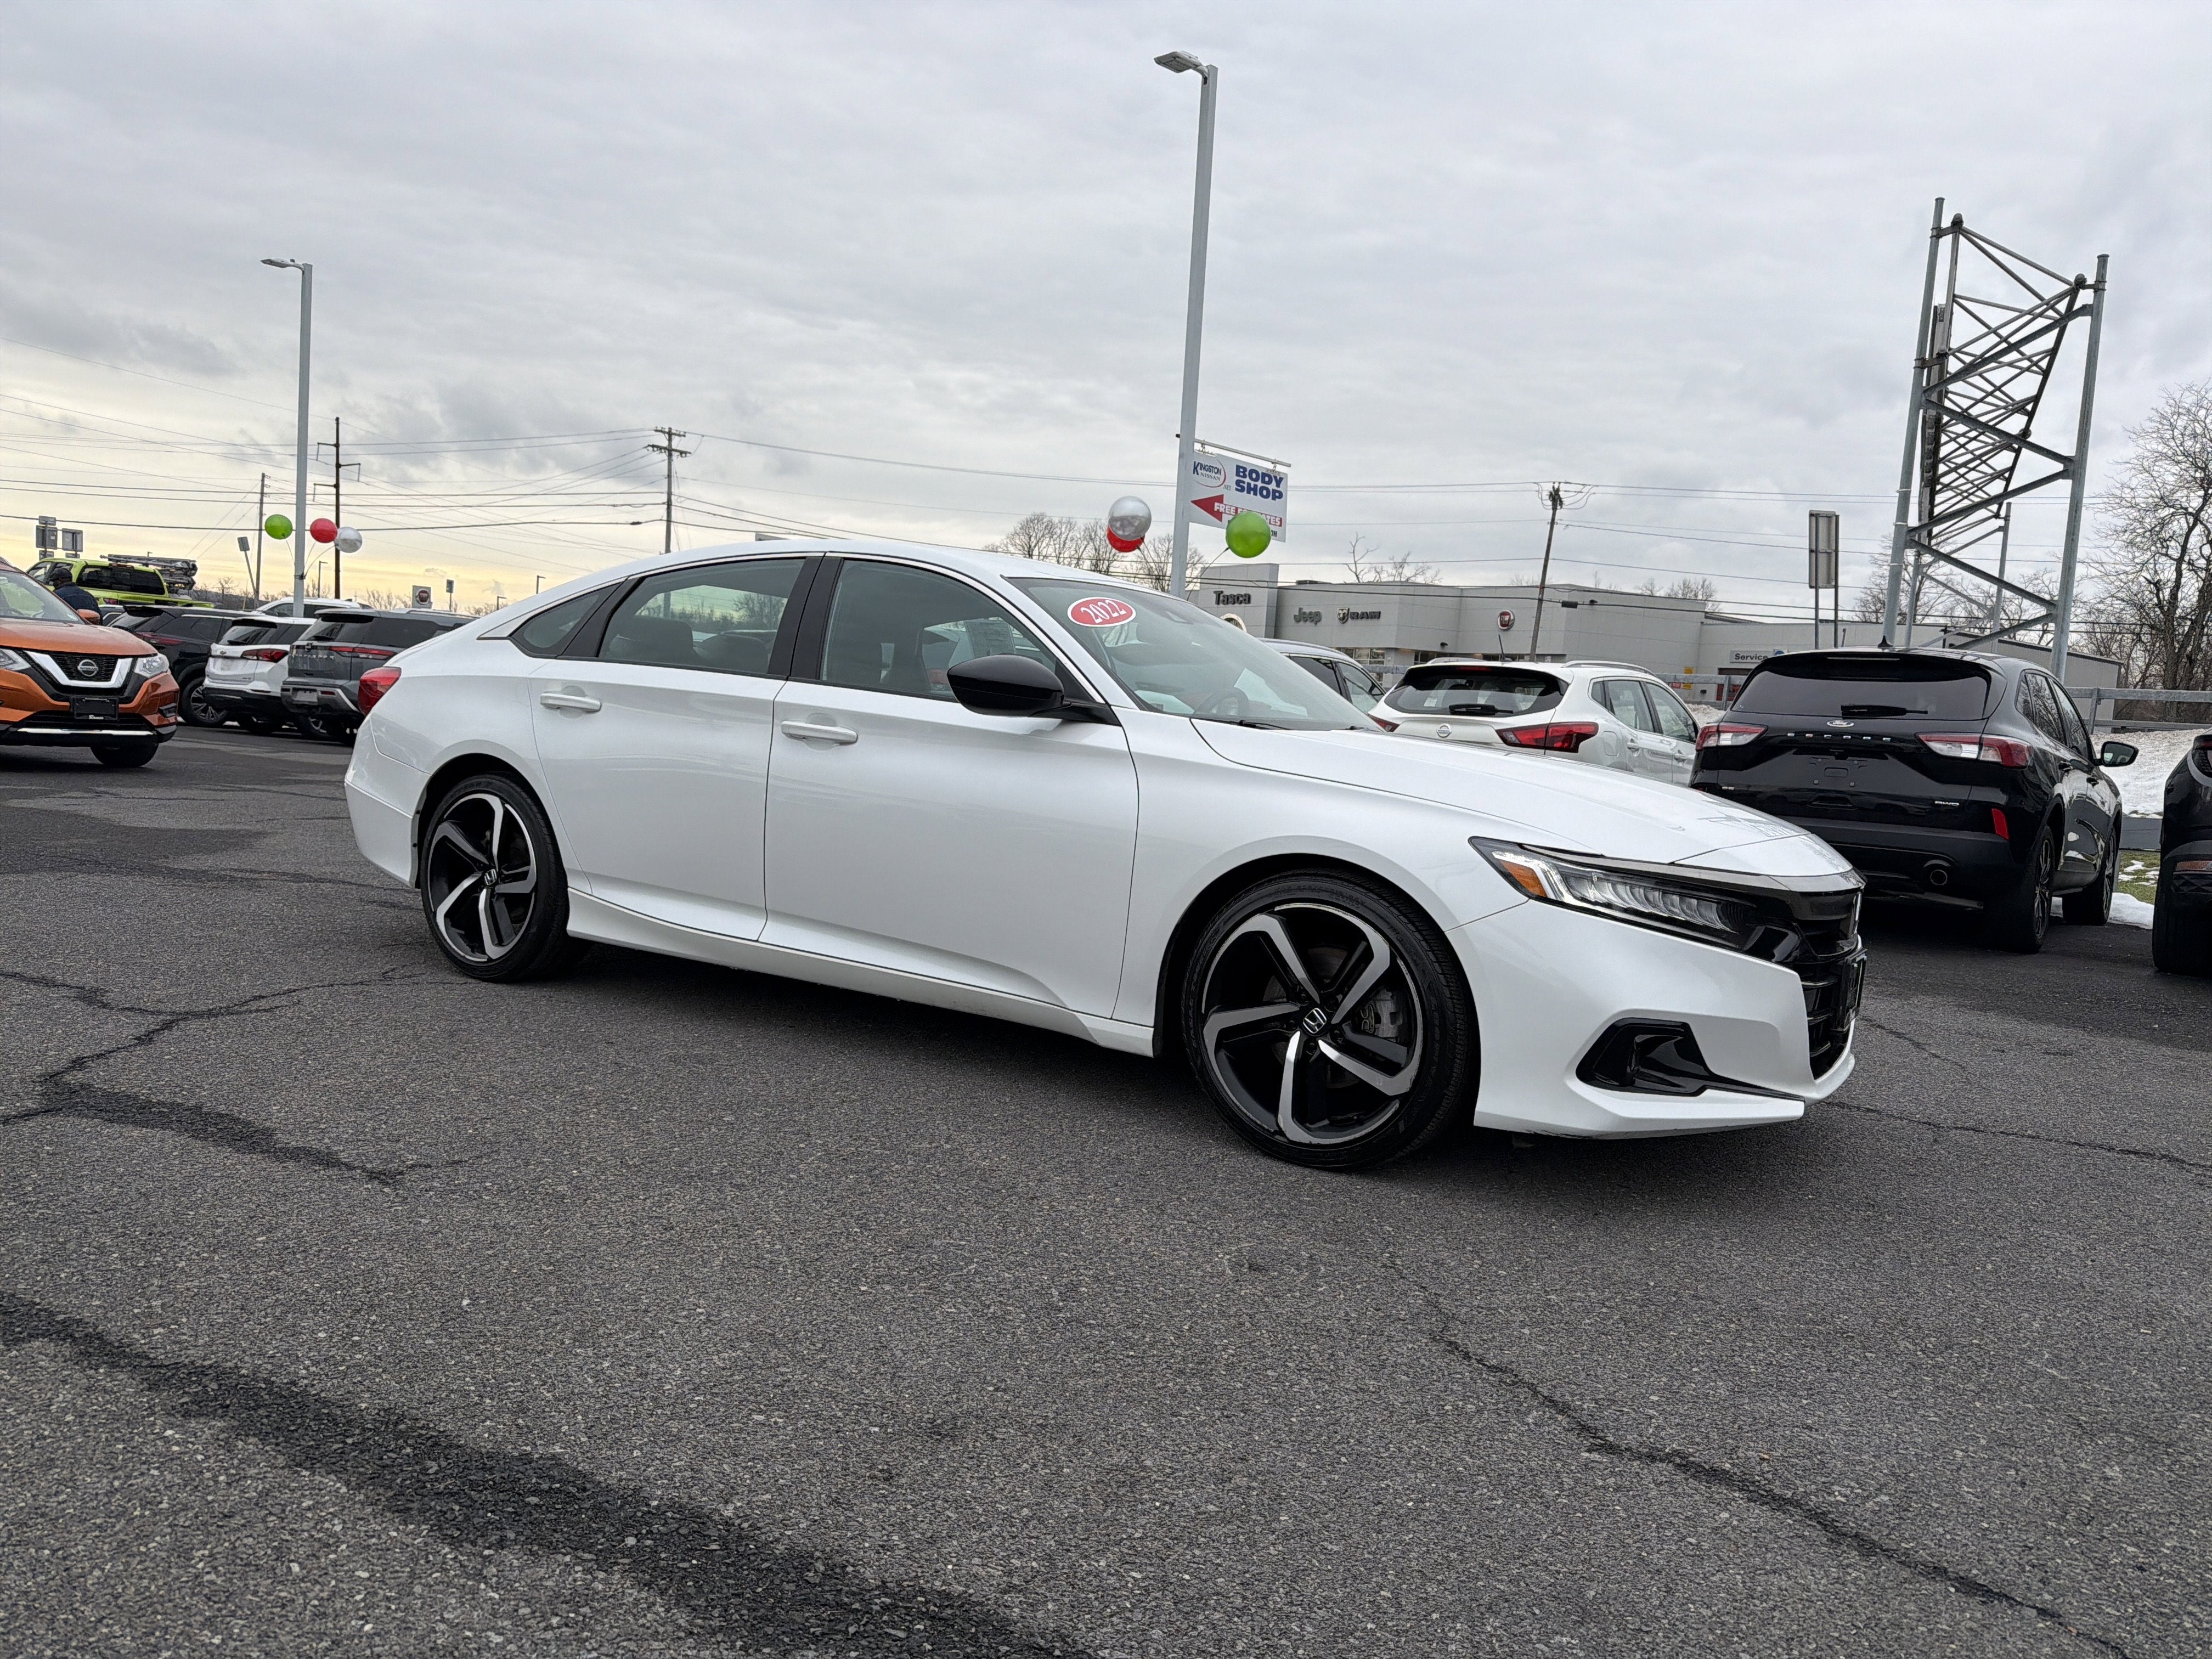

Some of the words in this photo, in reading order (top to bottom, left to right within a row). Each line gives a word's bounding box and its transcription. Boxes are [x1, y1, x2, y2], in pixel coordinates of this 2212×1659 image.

[1193, 461, 1222, 476] KINGSTON
[1235, 464, 1284, 488] BODY
[1200, 472, 1221, 481] NISSAN
[1235, 479, 1283, 501] SHOP
[1214, 502, 1235, 515] FREE
[1213, 590, 1251, 605] Tasca
[1080, 600, 1127, 623] 2022
[1294, 607, 1322, 625] Jeep
[1350, 611, 1381, 620] RAM
